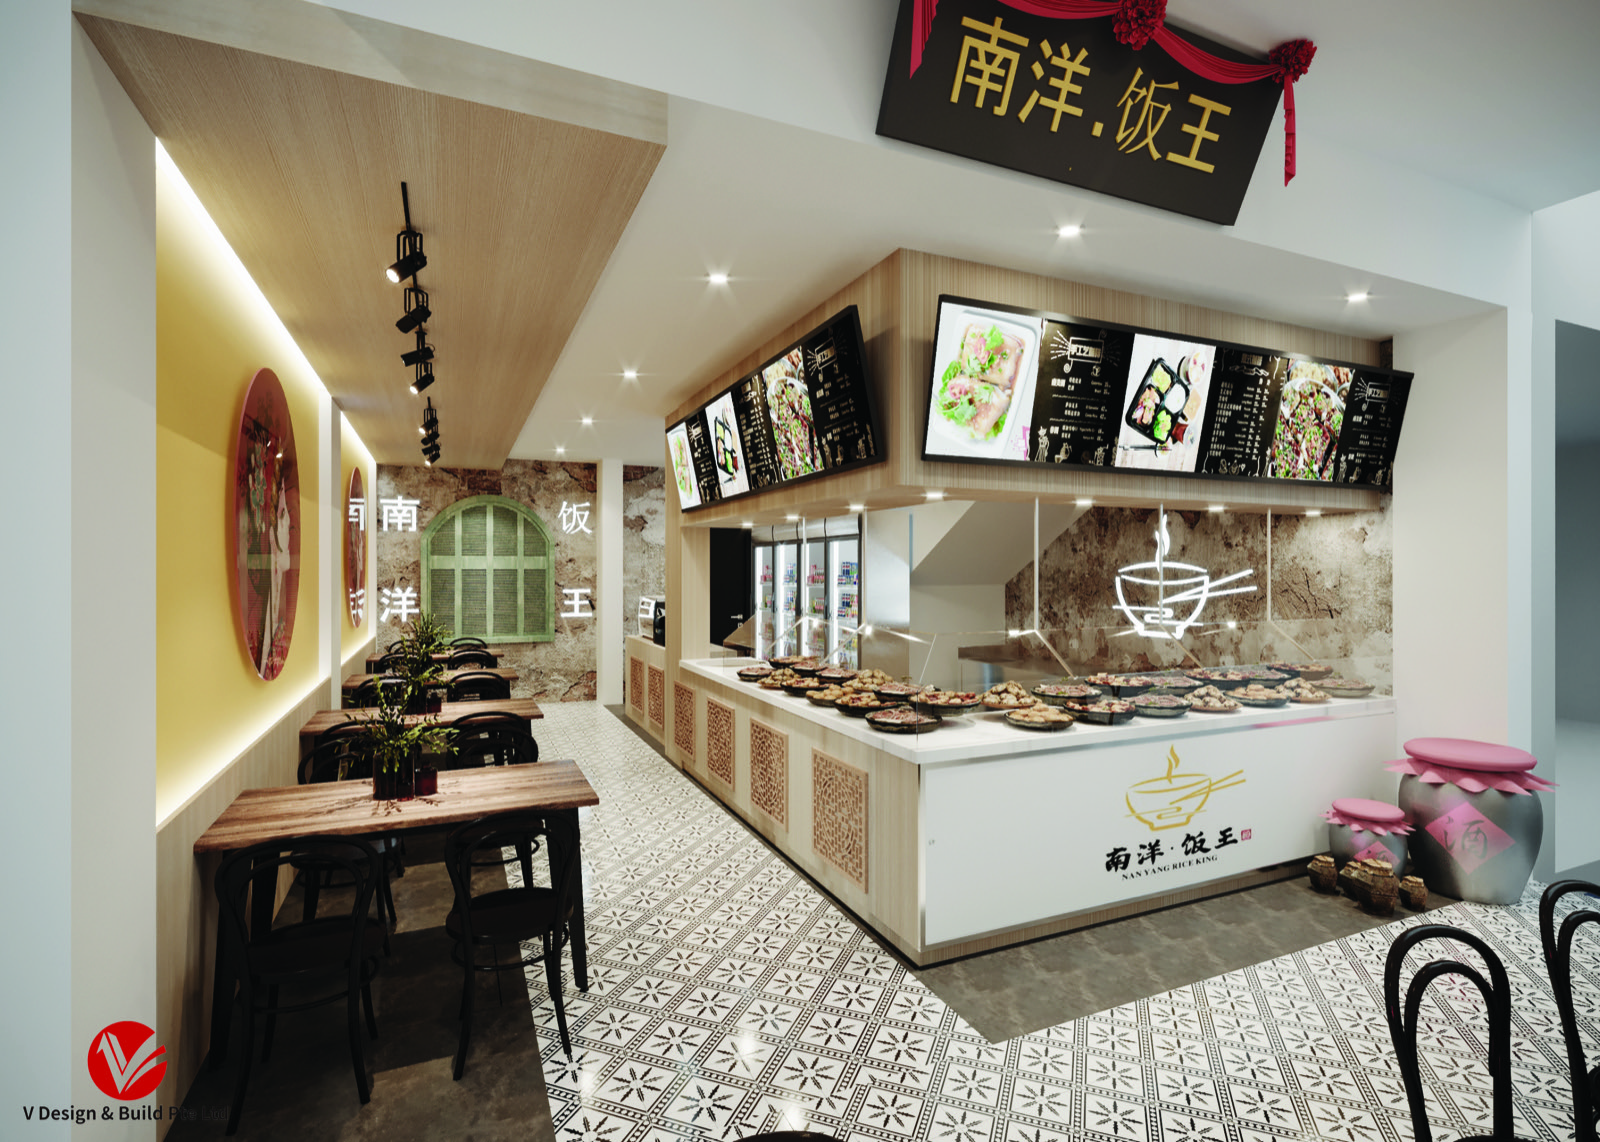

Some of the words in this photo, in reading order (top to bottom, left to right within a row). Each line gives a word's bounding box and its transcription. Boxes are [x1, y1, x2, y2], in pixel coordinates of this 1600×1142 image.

[1443, 815, 1488, 860] 酒
[1122, 870, 1142, 881] NAN
[1144, 864, 1170, 876] YANG
[1172, 859, 1195, 870] RICE
[1195, 854, 1218, 865] KING
